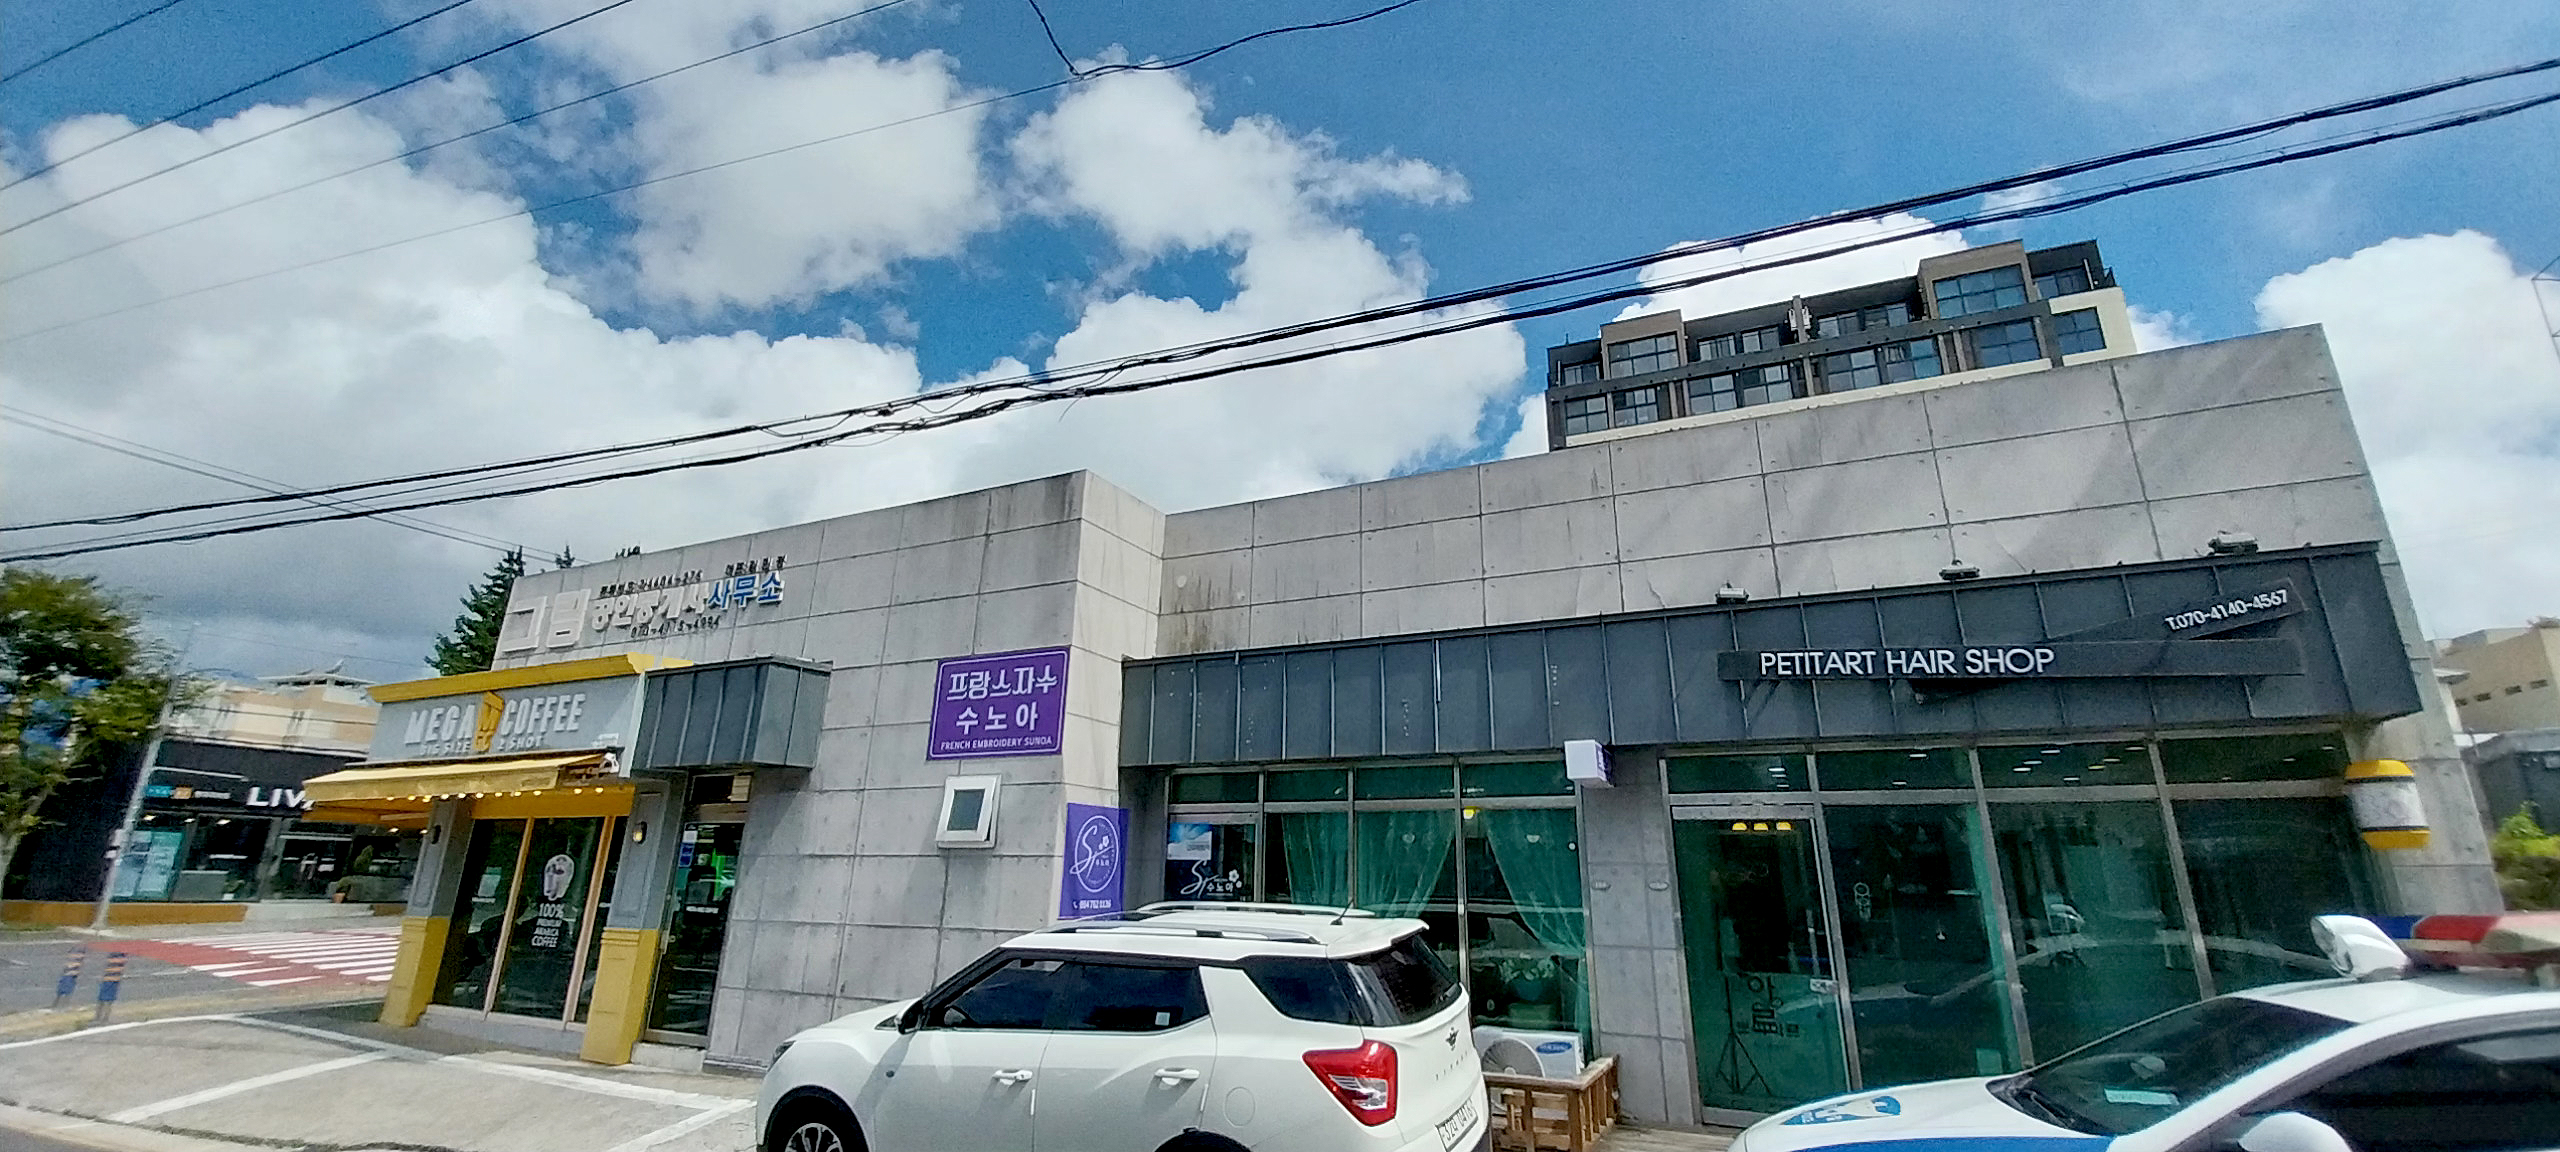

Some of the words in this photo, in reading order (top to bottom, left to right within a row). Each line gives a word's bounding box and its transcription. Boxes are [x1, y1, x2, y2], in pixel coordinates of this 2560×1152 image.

[2165, 589, 2288, 631] T.070-4140-4567
[1760, 651, 1876, 676] PETITART
[1885, 649, 1957, 675] HAIR
[1965, 648, 2055, 675] SHOP
[946, 664, 1058, 702] 프랑스자수
[405, 704, 476, 745] MEGA
[500, 693, 587, 736] COFFEE
[443, 741, 472, 755] SIZE
[507, 735, 544, 751] SHOT
[940, 740, 971, 751] FRENCH
[972, 737, 1022, 749] EMBROIDERY
[539, 903, 564, 918] 100%
[531, 935, 558, 948] COFFEE
